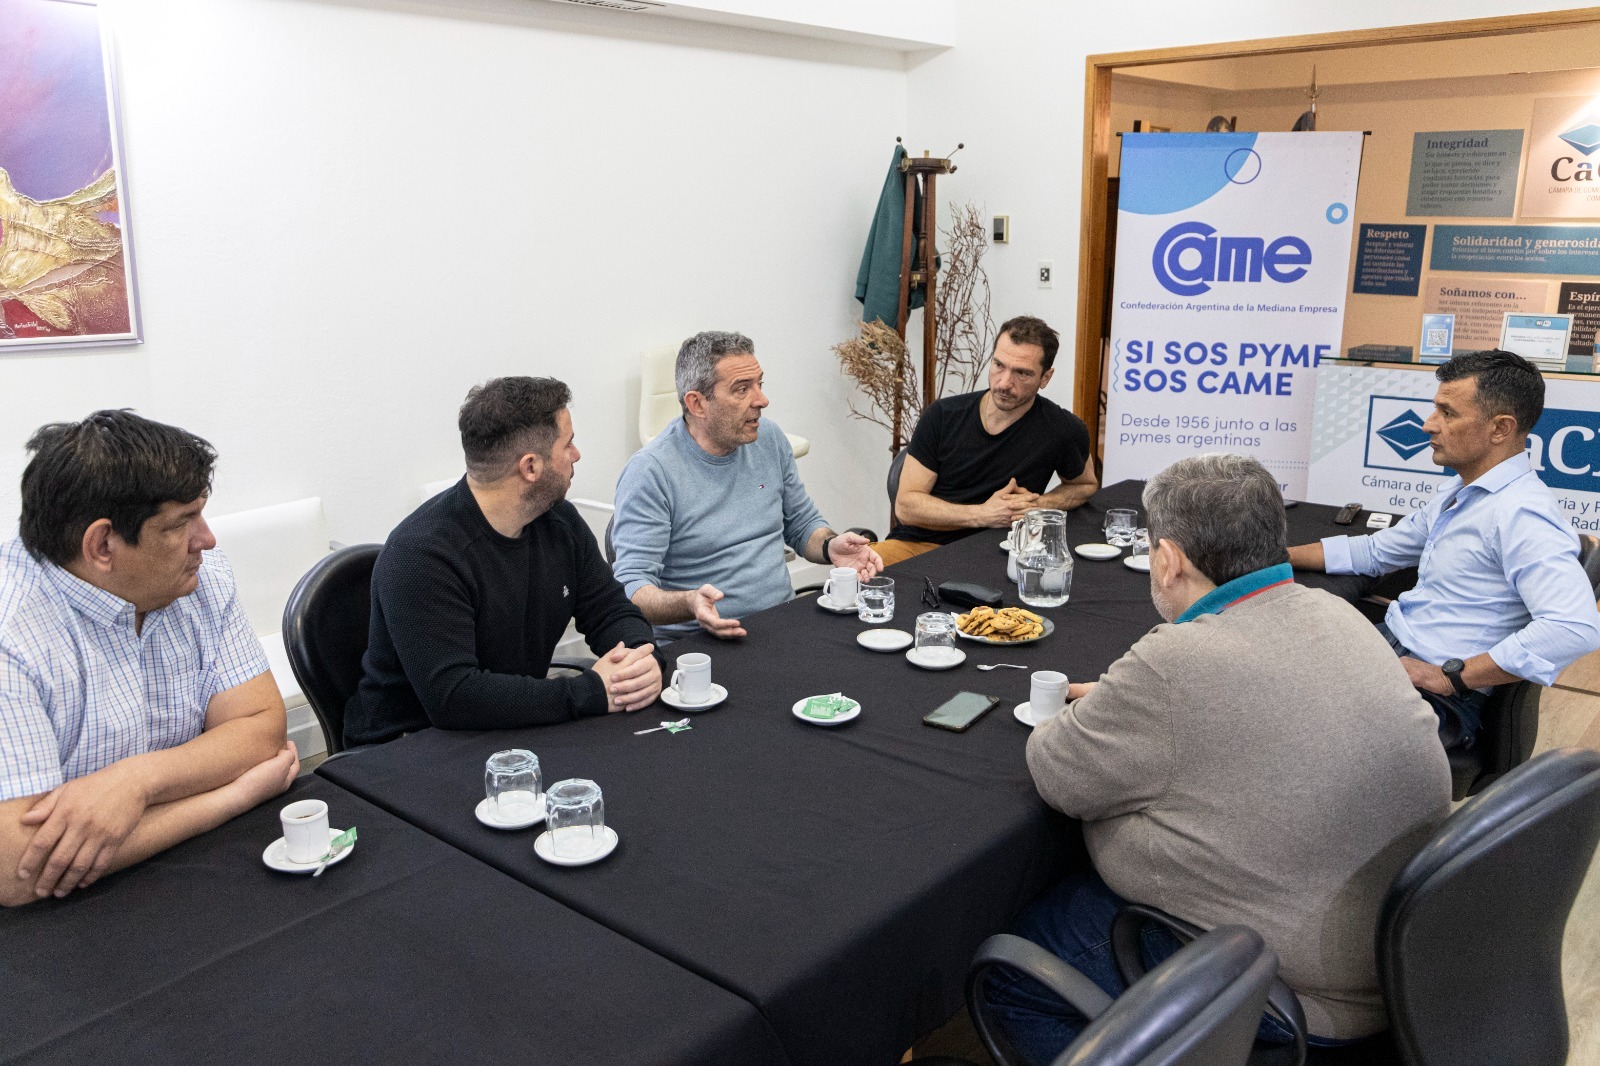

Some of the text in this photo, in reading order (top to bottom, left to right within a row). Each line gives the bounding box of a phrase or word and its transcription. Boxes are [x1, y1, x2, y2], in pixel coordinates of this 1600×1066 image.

[1427, 138, 1488, 150] Integridad
[1551, 156, 1600, 182] Ca
[1367, 229, 1410, 240] Respeto
[1453, 236, 1522, 247] Solidaridad
[1525, 239, 1533, 249] y
[1440, 287, 1527, 300] Soñamos con...
[1120, 301, 1338, 314] Confederación Argentina de la Mediana Empresa
[1126, 340, 1154, 364] SI
[1163, 341, 1228, 366] SOS
[1124, 368, 1293, 396] SOS CAME
[1121, 413, 1297, 433] Desde 1956 junto a las
[1119, 432, 1261, 449] pymes argentinas
[1361, 475, 1411, 491] Cámara
[1415, 481, 1432, 494] de
[1389, 494, 1429, 509] de Co
[1580, 502, 1590, 515] y
[1571, 516, 1600, 531] Rad
